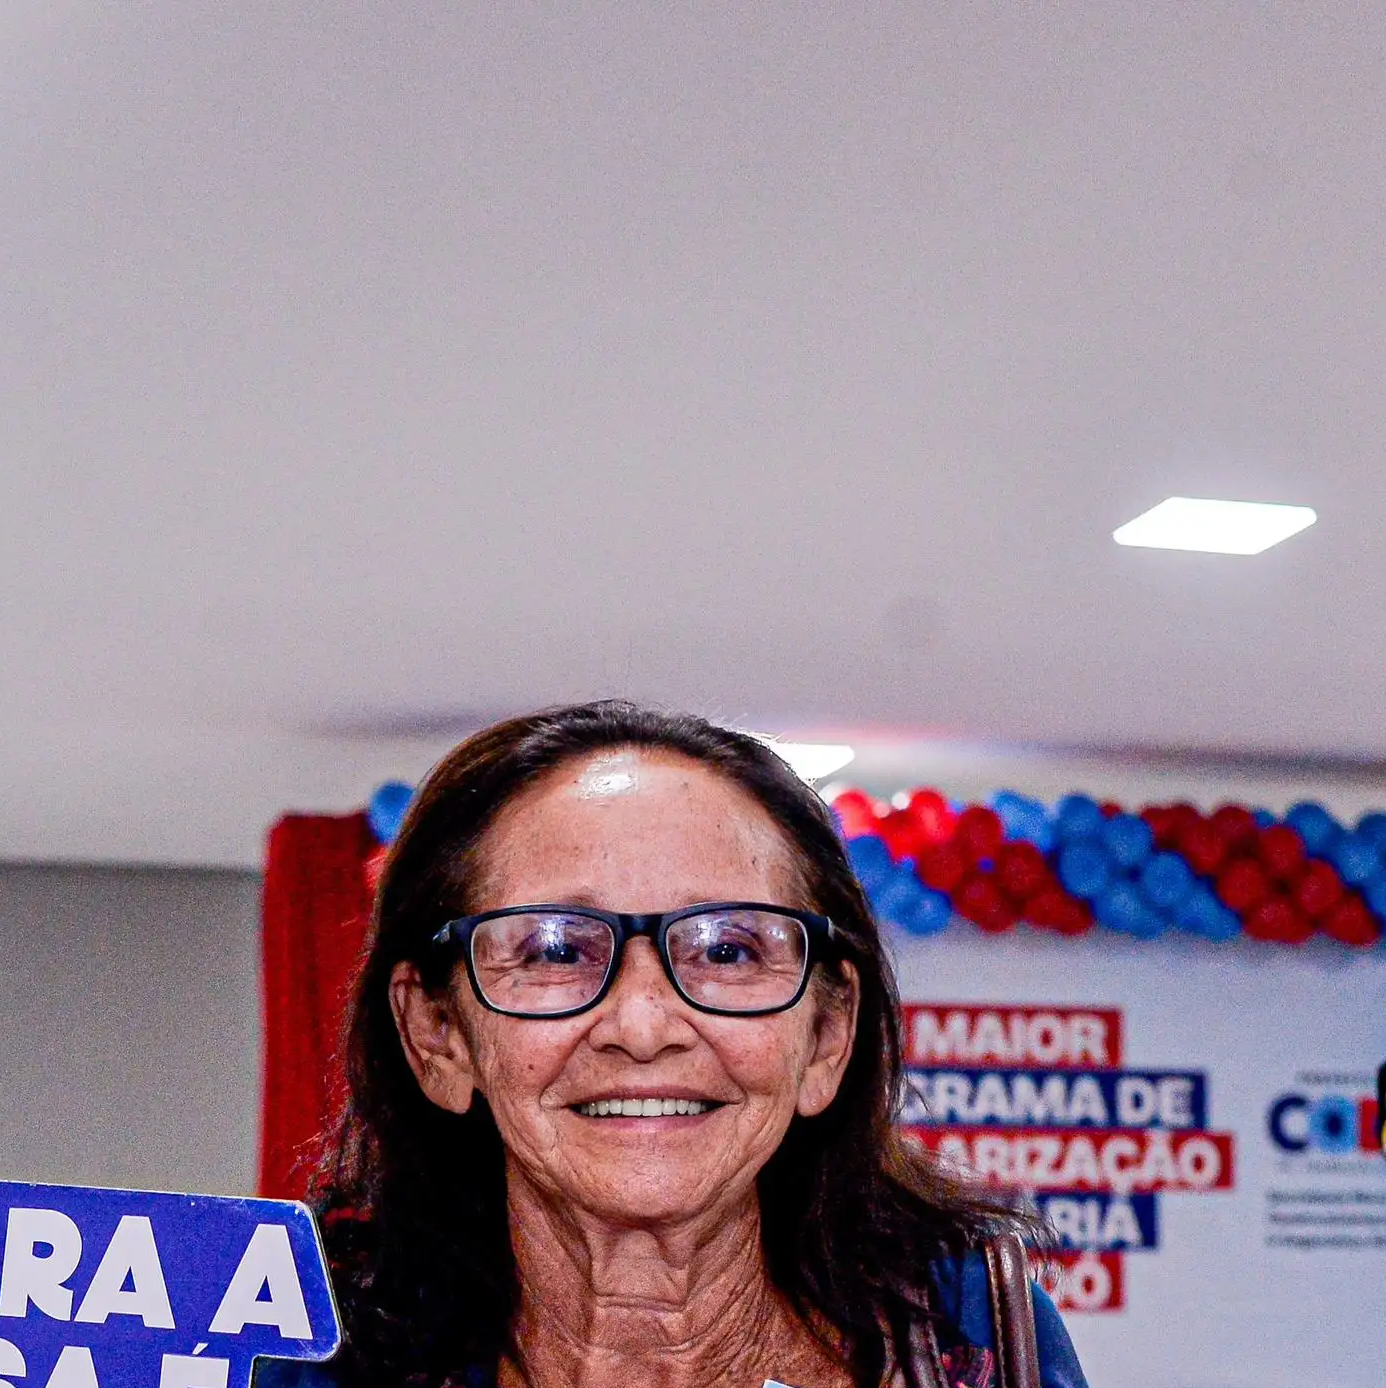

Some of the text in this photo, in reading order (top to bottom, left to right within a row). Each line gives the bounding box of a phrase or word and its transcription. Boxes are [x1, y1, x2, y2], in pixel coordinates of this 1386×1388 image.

[915, 1010, 1107, 1065] MAIOR
[898, 1070, 1195, 1128] GRAMA DE
[936, 1128, 1222, 1196] ARIZAÇÃO
[208, 1223, 314, 1341] A
